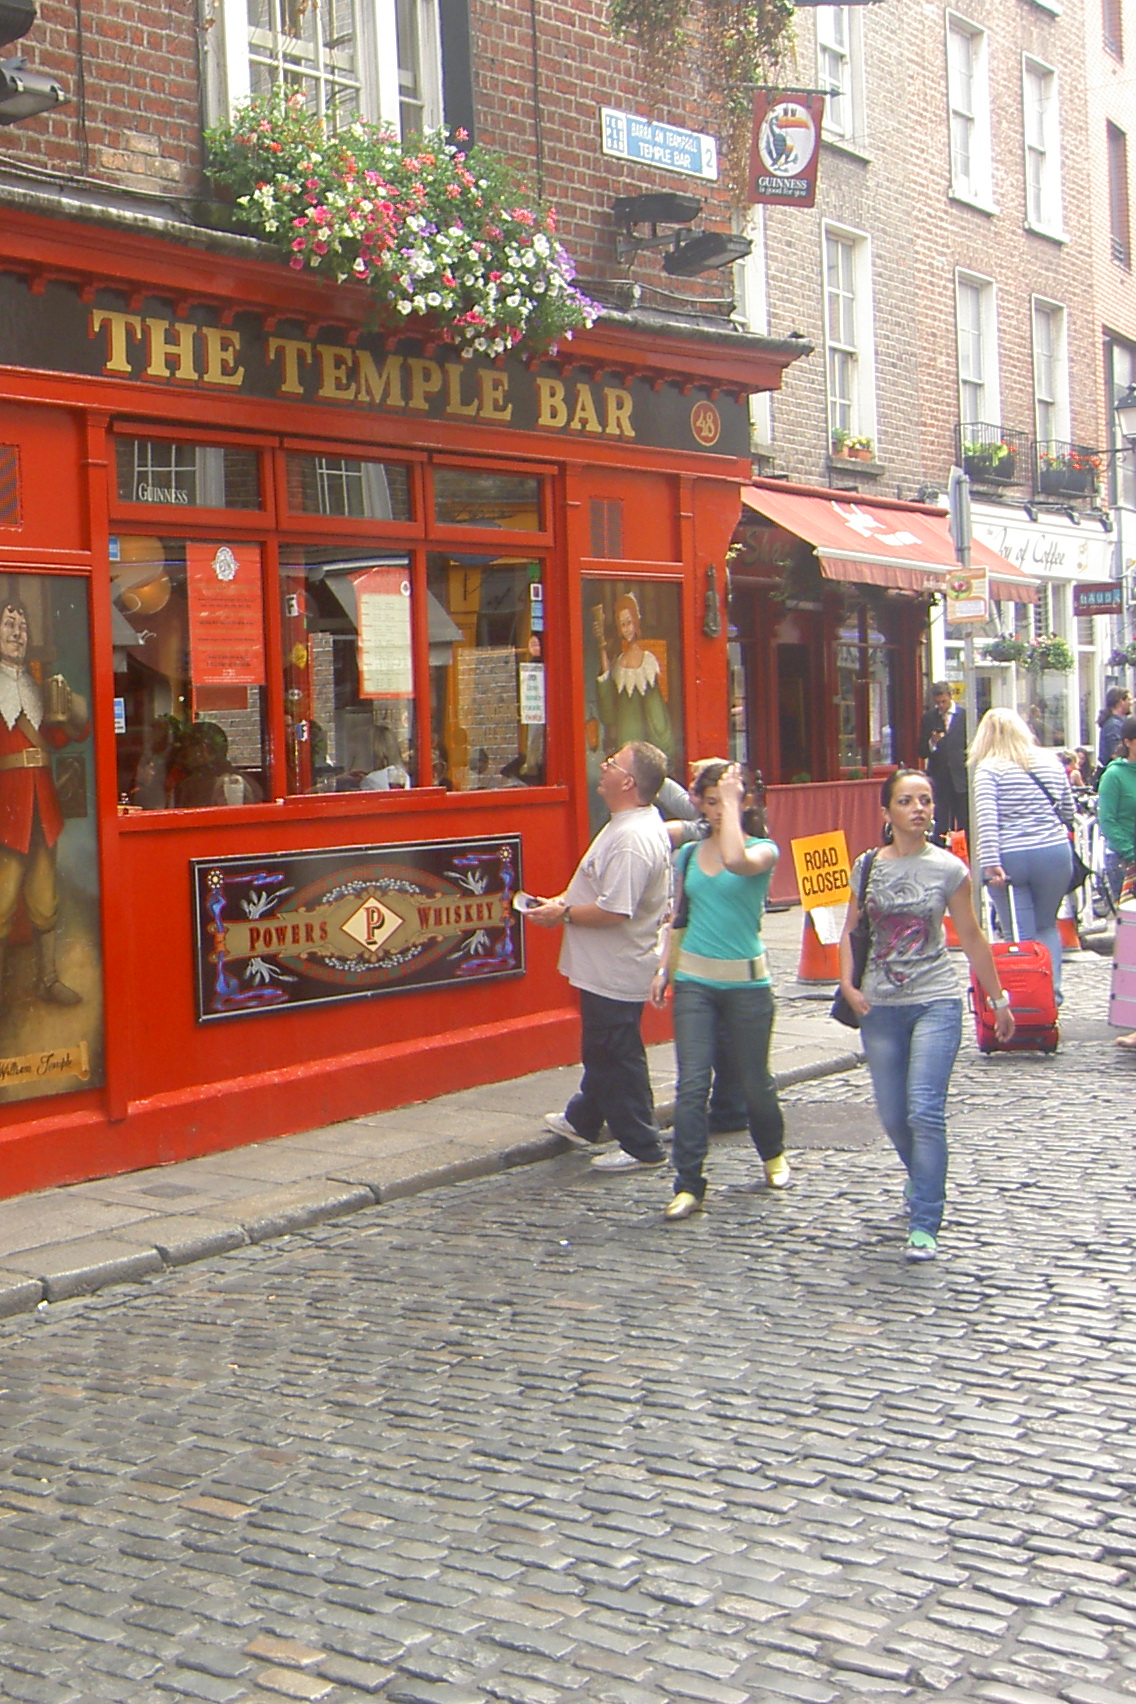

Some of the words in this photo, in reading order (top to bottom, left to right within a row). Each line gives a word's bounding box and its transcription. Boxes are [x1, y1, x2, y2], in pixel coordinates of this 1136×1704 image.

[631, 122, 652, 140] BARRA
[654, 129, 664, 144] AN
[638, 142, 672, 163] TEMPLE
[673, 151, 691, 169] BAR
[705, 148, 713, 168] 2
[758, 176, 807, 190] GUINNESS
[88, 308, 246, 393] THE
[269, 337, 513, 424] TEMPLE
[535, 376, 637, 443] BAR
[694, 409, 720, 441] 48
[139, 482, 188, 504] GUINNESS
[1015, 538, 1030, 569] of
[1032, 533, 1066, 572] Coffee
[804, 847, 839, 872] ROAD
[802, 869, 849, 896] CLOSED
[249, 920, 328, 950] POWERS
[363, 906, 385, 946] P
[416, 900, 495, 931] WHISKEY
